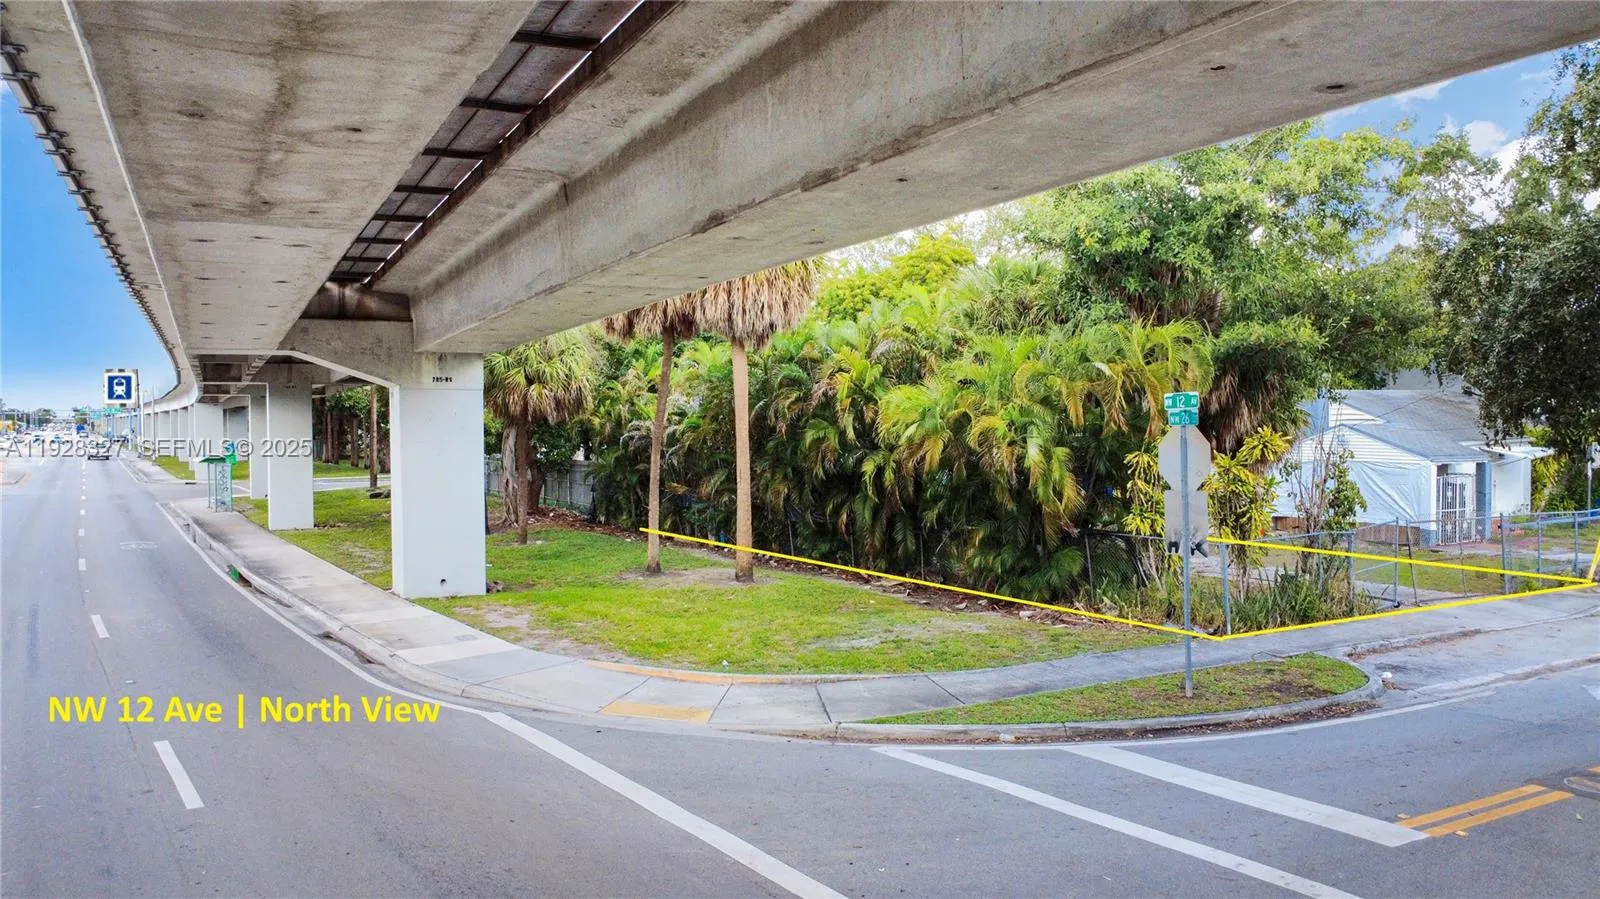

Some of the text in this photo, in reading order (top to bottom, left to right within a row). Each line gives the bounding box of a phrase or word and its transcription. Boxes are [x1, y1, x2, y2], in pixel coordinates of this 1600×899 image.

[1176, 395, 1186, 408] 12
[1170, 412, 1190, 425] NW 26
